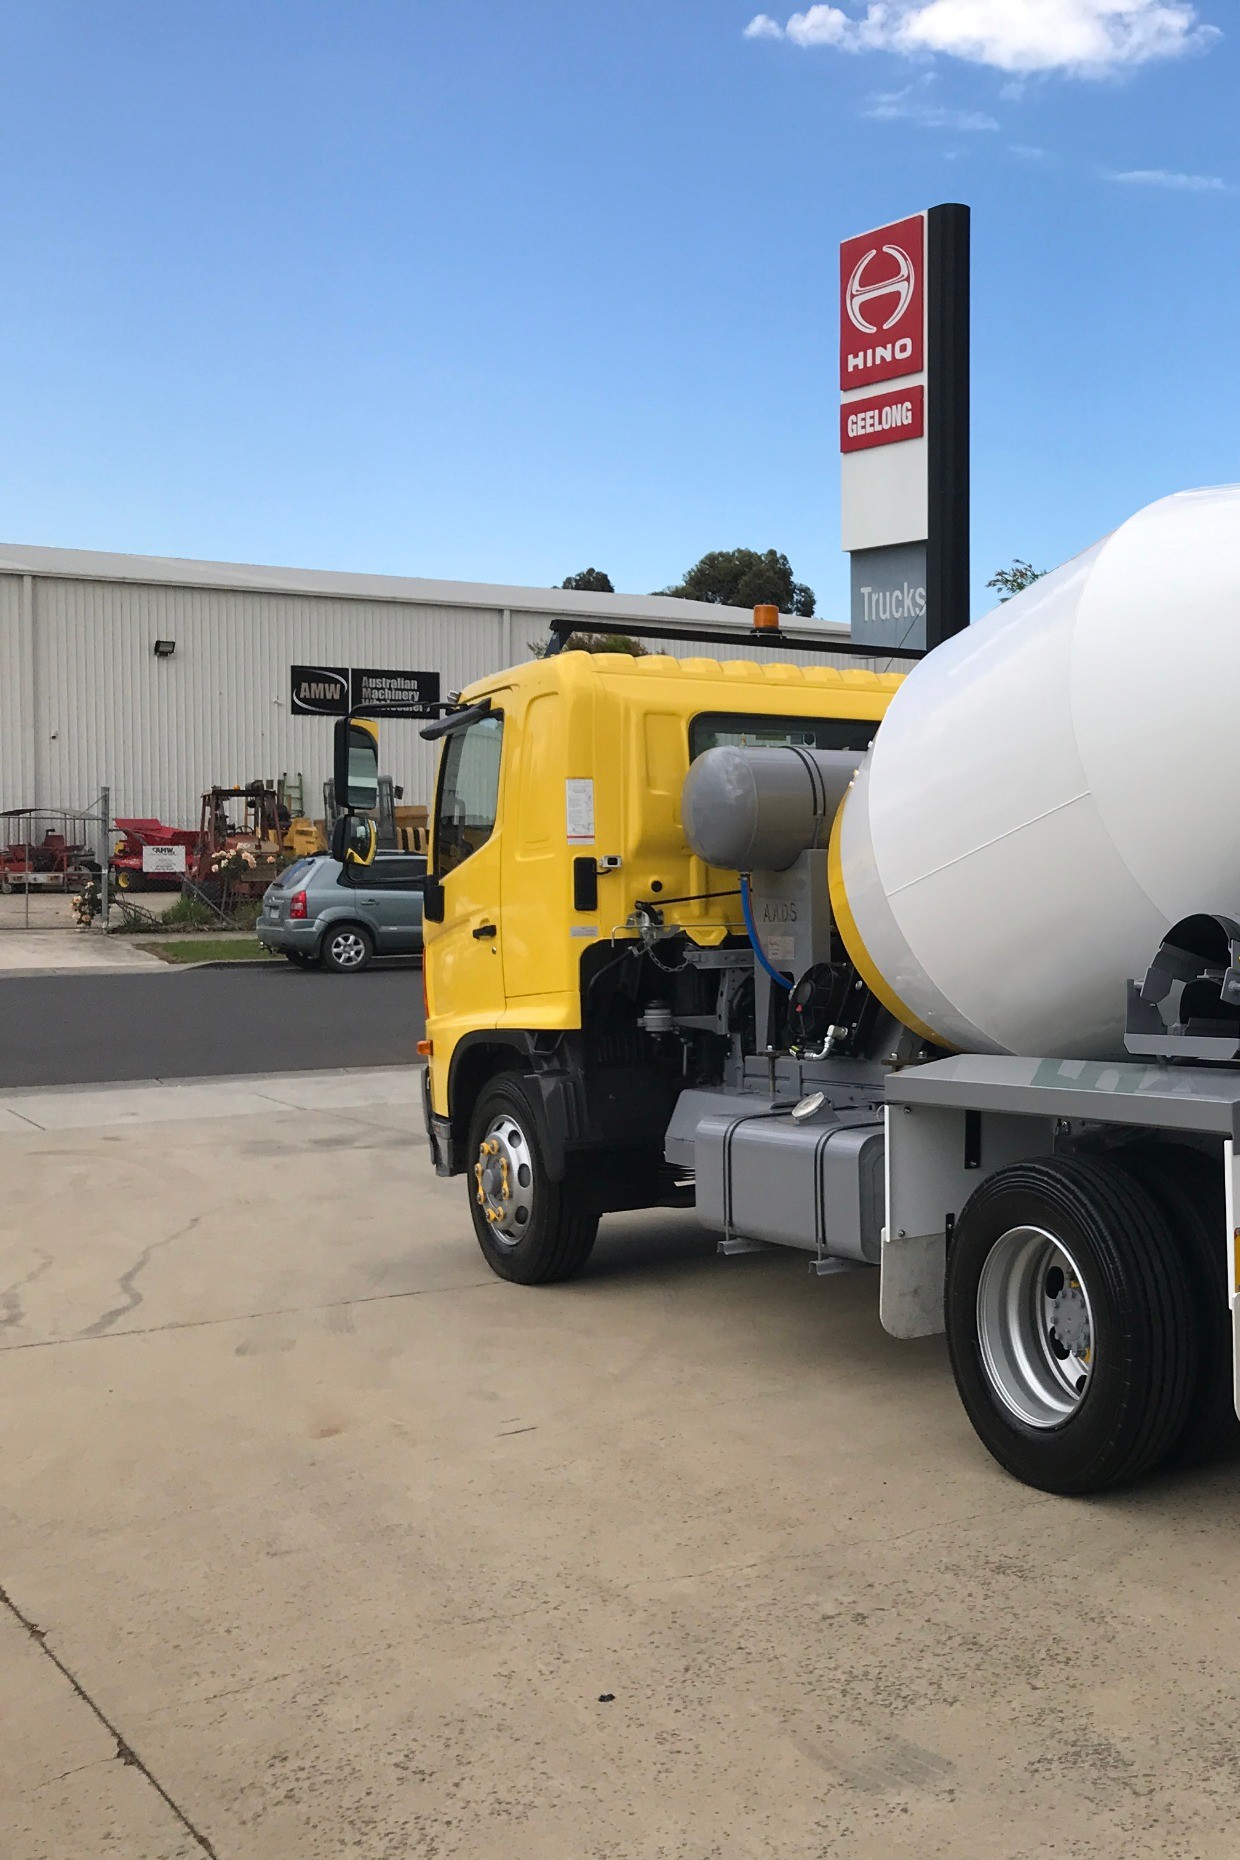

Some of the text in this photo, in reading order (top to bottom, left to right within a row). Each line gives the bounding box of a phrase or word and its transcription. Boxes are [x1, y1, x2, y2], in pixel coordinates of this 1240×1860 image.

[847, 337, 912, 372] HINO
[847, 401, 913, 438] GEELONG
[860, 582, 927, 621] Trucks
[300, 682, 341, 699] AMW
[361, 676, 418, 690] Australian
[361, 687, 420, 702] Machinery
